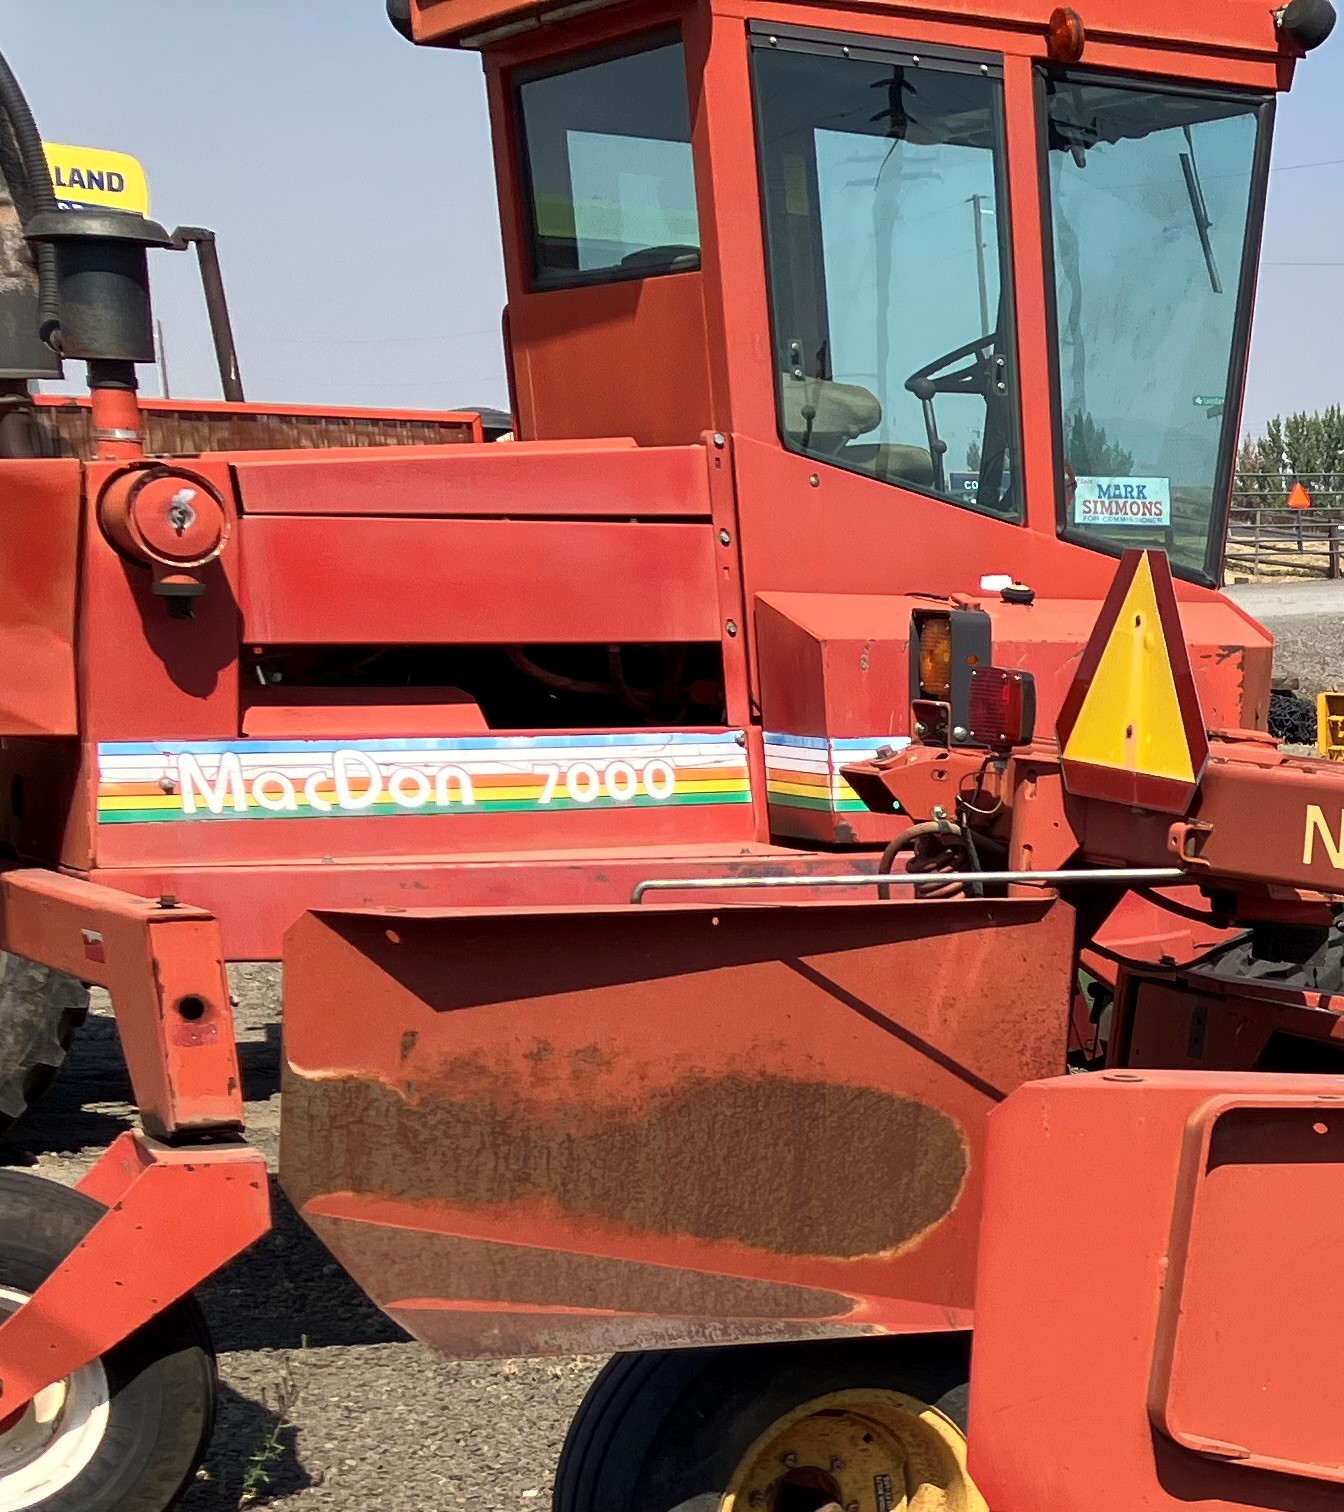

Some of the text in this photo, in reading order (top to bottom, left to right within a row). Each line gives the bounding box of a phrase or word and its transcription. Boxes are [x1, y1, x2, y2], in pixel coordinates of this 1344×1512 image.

[1097, 483, 1147, 499] MARK
[1082, 499, 1163, 517] SIMMONS
[1102, 516, 1163, 524] COMMISSIONER
[177, 749, 676, 813] MacDon 7000
